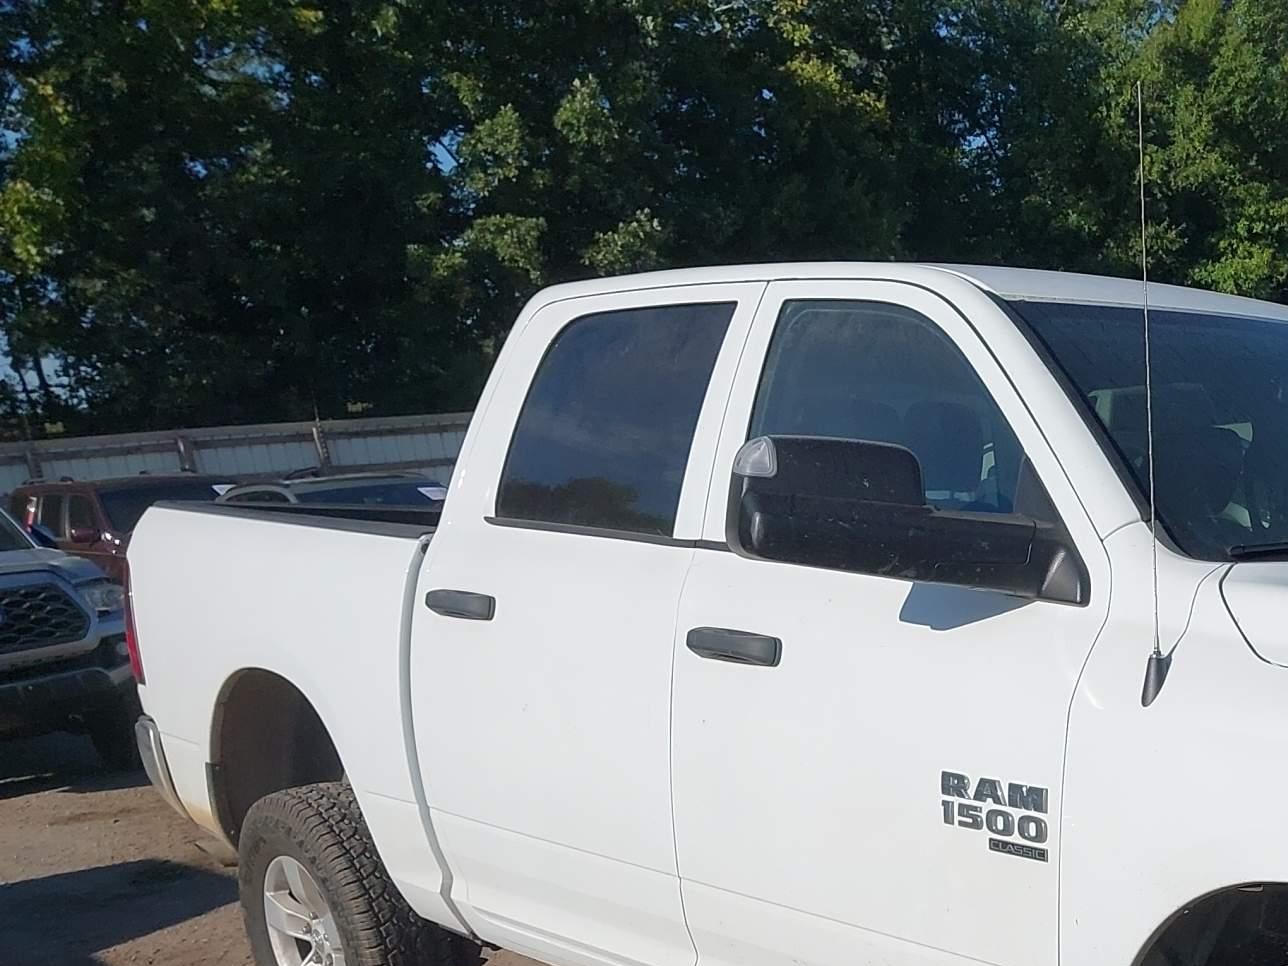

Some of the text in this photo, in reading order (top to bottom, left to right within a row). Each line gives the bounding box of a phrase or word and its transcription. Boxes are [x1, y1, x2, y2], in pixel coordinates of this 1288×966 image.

[941, 770, 1049, 814] RAM
[941, 800, 1049, 844] 1500
[989, 839, 1048, 862] CLASSIC
